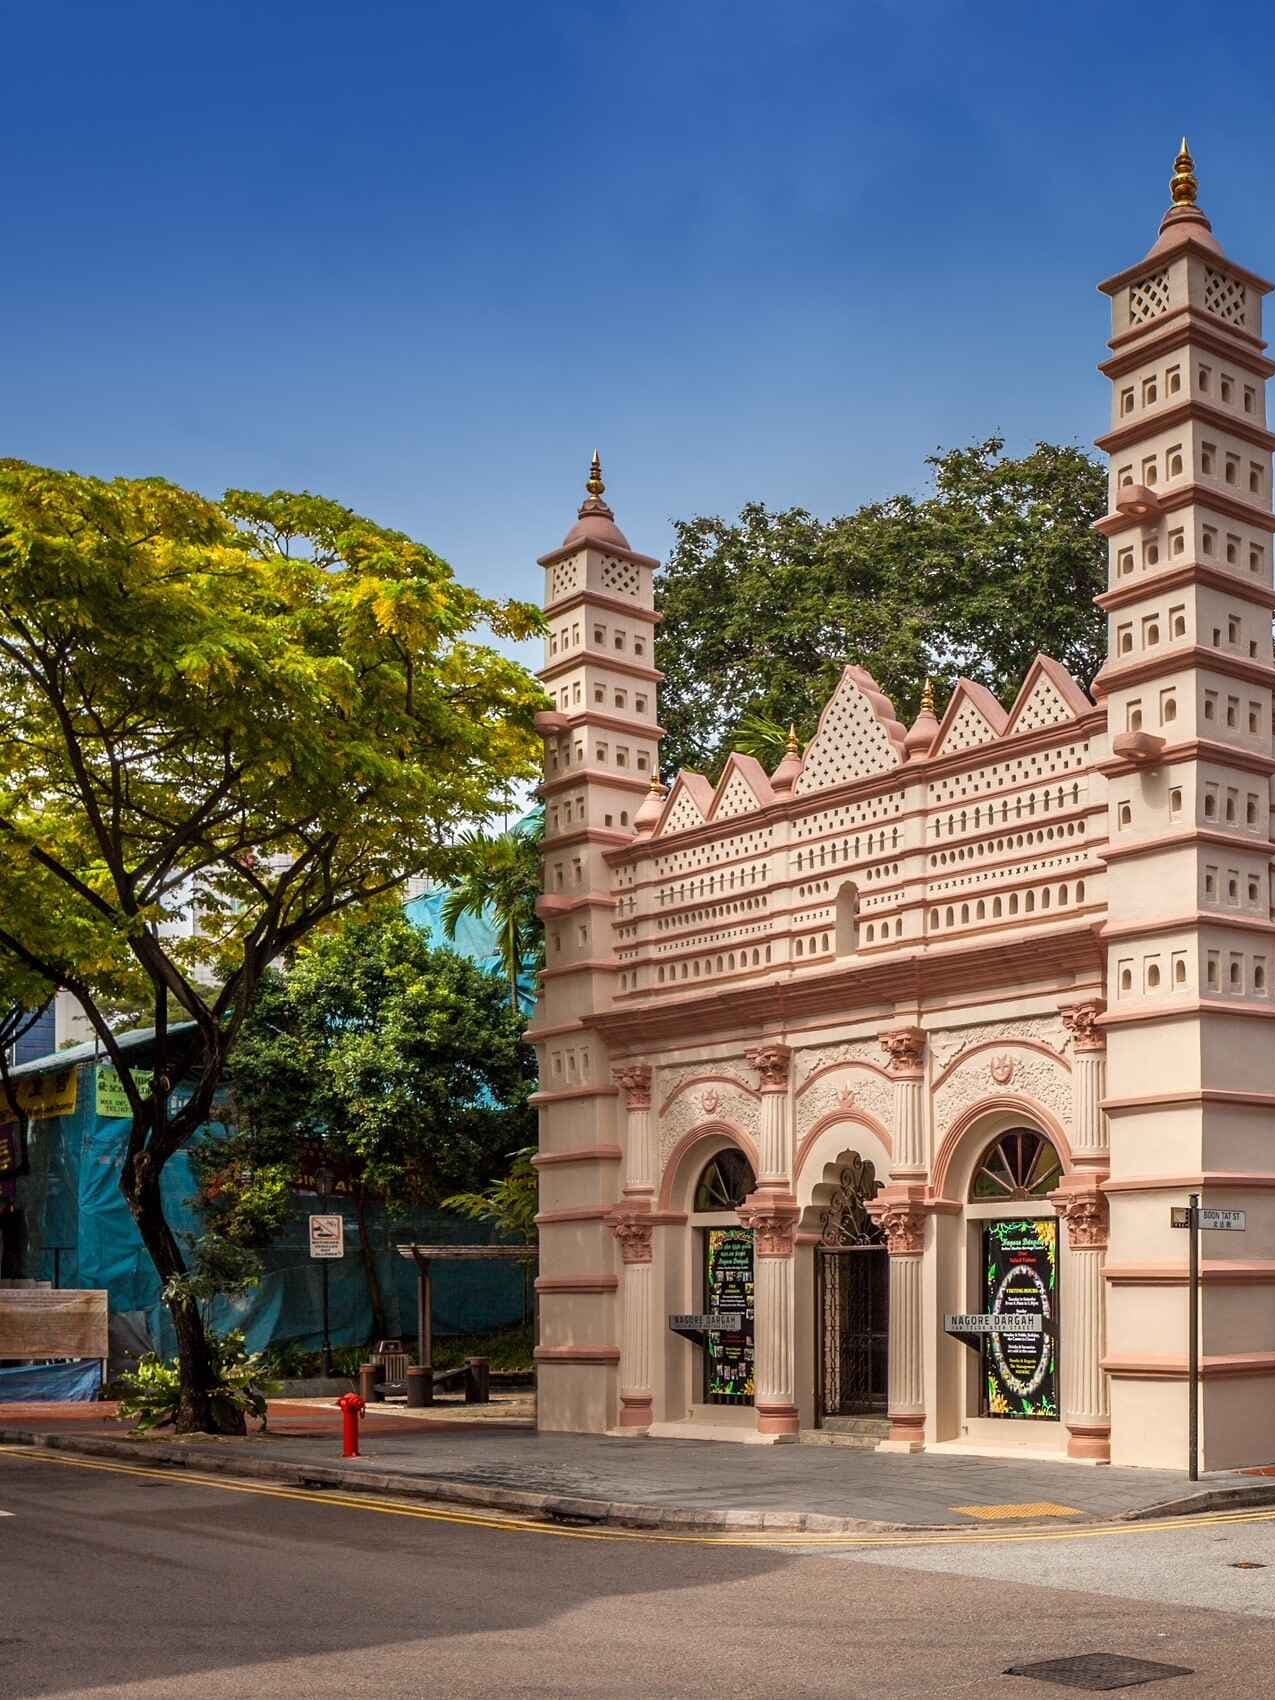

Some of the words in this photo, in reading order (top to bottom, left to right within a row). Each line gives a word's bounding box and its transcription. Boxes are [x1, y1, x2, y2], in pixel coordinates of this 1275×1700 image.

[1203, 1209, 1220, 1220] BOON
[1221, 1211, 1232, 1220] TAT
[1232, 1212, 1241, 1221] ST
[706, 1316, 736, 1325] DARGAH
[951, 1316, 990, 1325] NAGORE
[994, 1316, 1034, 1325] DARGAH
